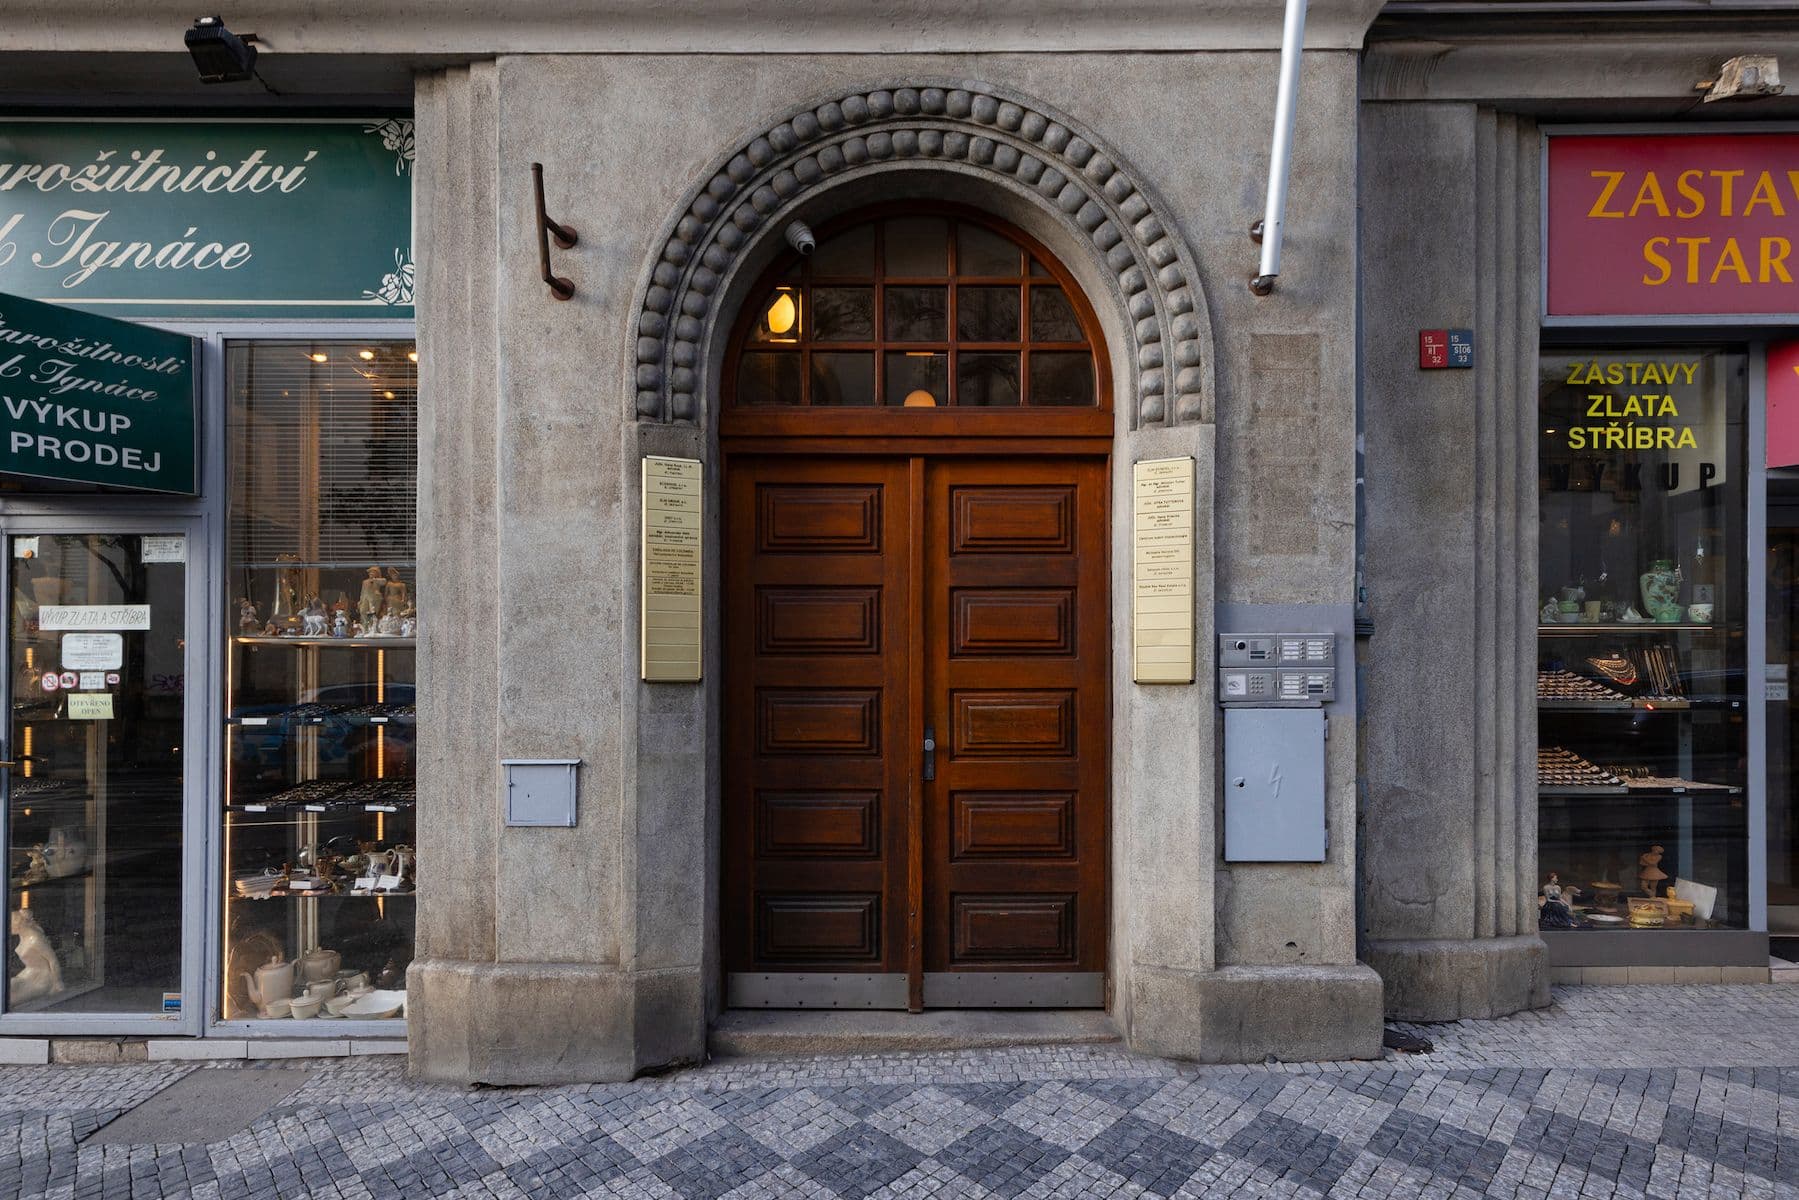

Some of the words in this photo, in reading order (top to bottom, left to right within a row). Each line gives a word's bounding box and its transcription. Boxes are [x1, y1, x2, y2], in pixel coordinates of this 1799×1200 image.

[32, 208, 253, 289] Ignáce
[1642, 236, 1793, 286] STAR
[1451, 335, 1459, 343] 15
[30, 358, 159, 402] Ignáce
[3, 396, 131, 435] VÝKUP
[1586, 395, 1679, 417] ZLATA
[10, 431, 161, 473] PRODEJ
[1567, 422, 1698, 450] STŘÍBRA
[68, 611, 98, 625] ZLATA
[100, 611, 107, 625] A
[109, 607, 147, 625] STŘÍBRA
